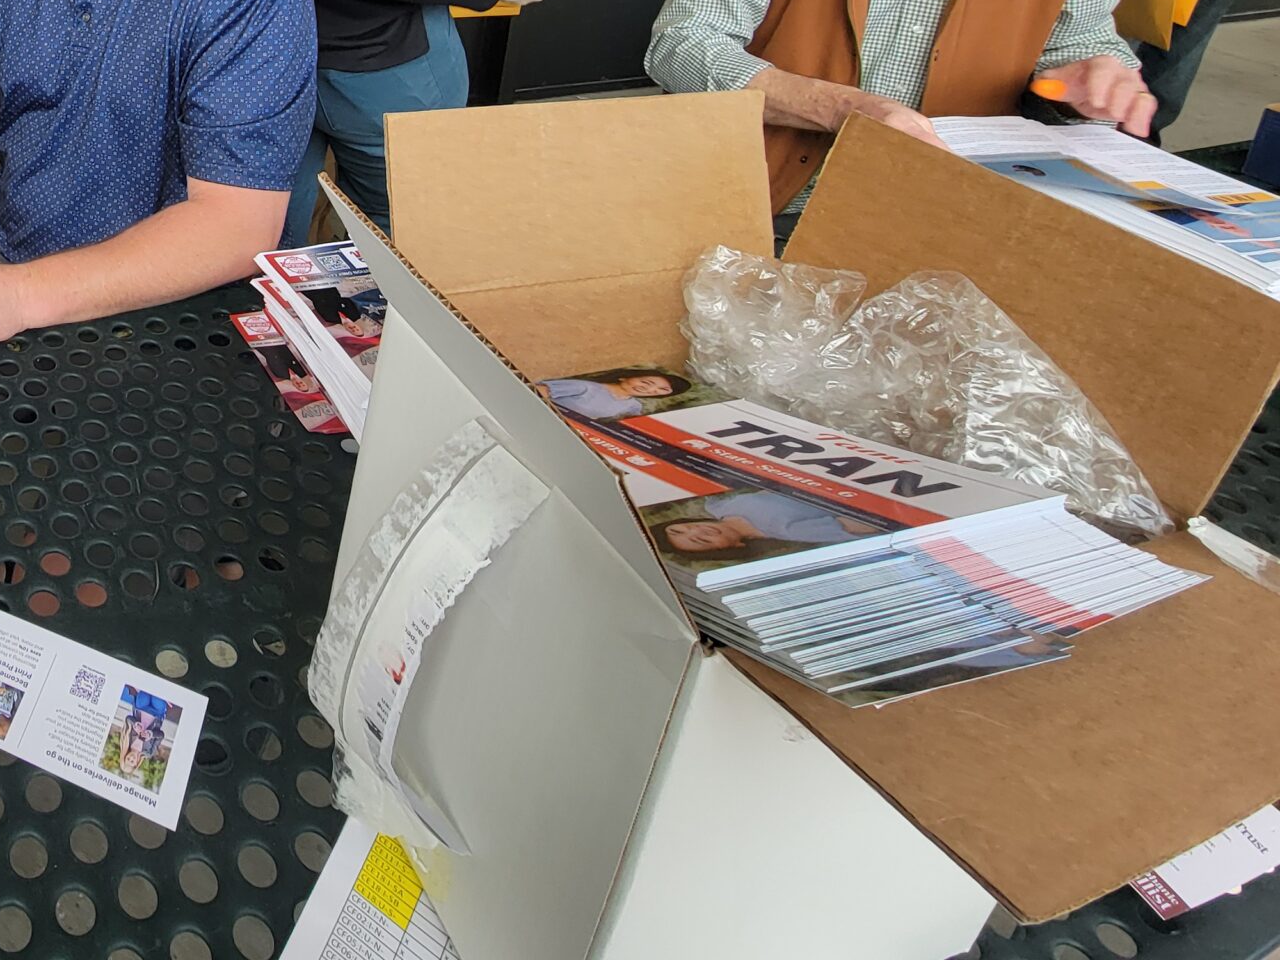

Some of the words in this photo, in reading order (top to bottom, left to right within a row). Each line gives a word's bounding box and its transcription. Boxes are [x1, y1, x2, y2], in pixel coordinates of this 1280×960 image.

[704, 420, 964, 498] TRAN
[815, 432, 918, 465] Tami
[709, 447, 754, 465] State
[758, 463, 823, 488] Senate
[836, 490, 856, 499] 6
[13, 666, 32, 679] Print
[45, 747, 57, 759] go
[56, 755, 70, 767] the
[71, 761, 82, 771] on
[82, 767, 122, 791] deliveries
[122, 783, 157, 807] Manage
